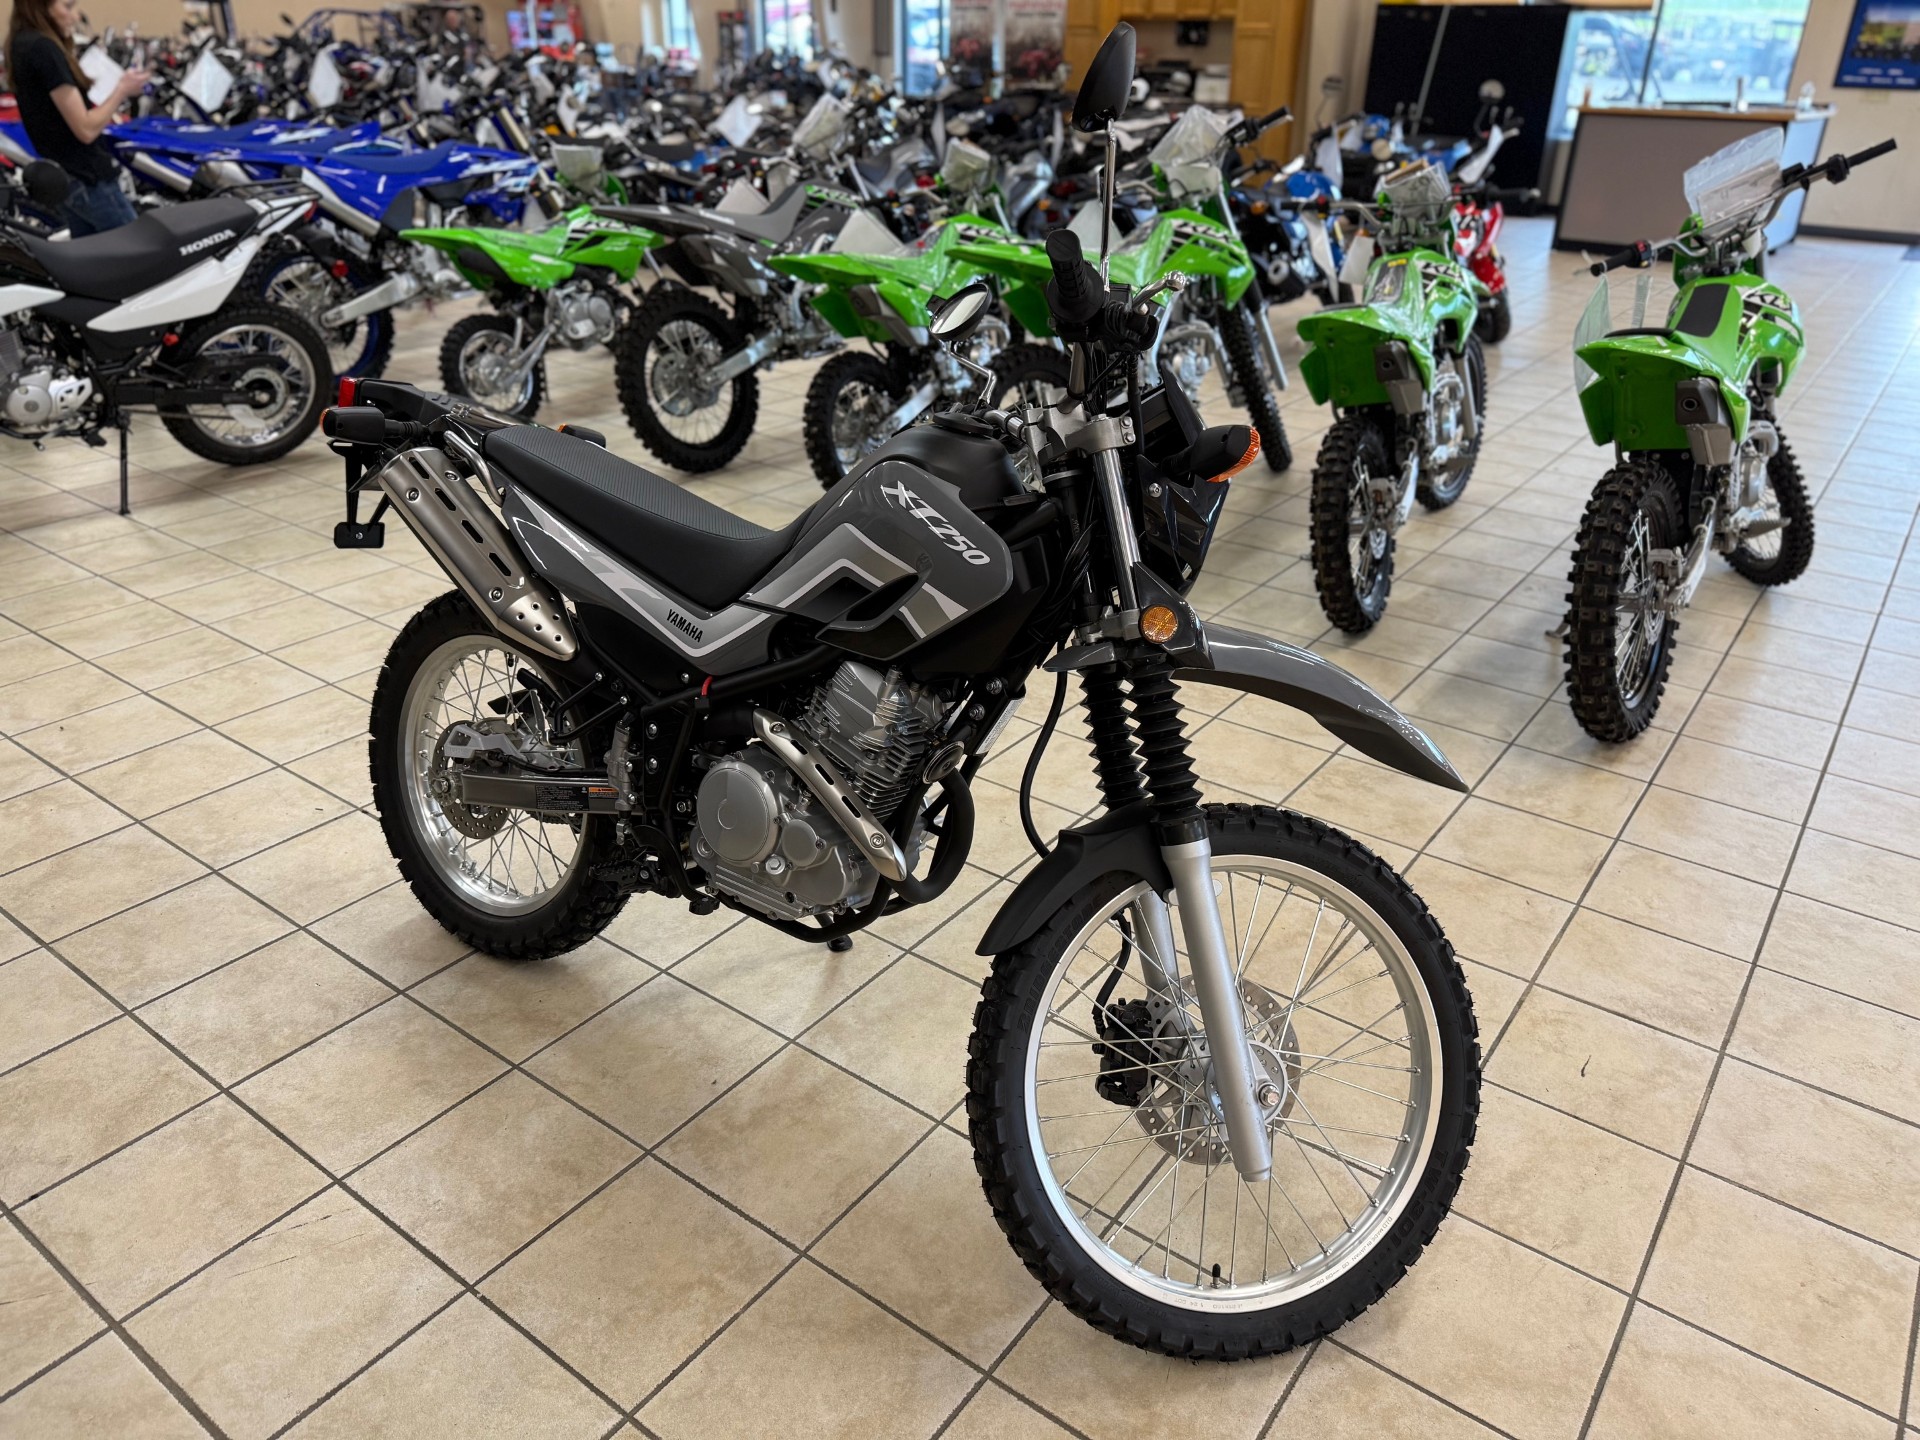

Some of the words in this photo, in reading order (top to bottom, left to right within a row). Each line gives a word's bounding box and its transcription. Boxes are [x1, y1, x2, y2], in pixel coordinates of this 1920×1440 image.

[179, 228, 237, 256] HONDA
[880, 480, 991, 565] XT250
[666, 608, 703, 643] YAMAHA
[1351, 1246, 1367, 1262] JAPAN
